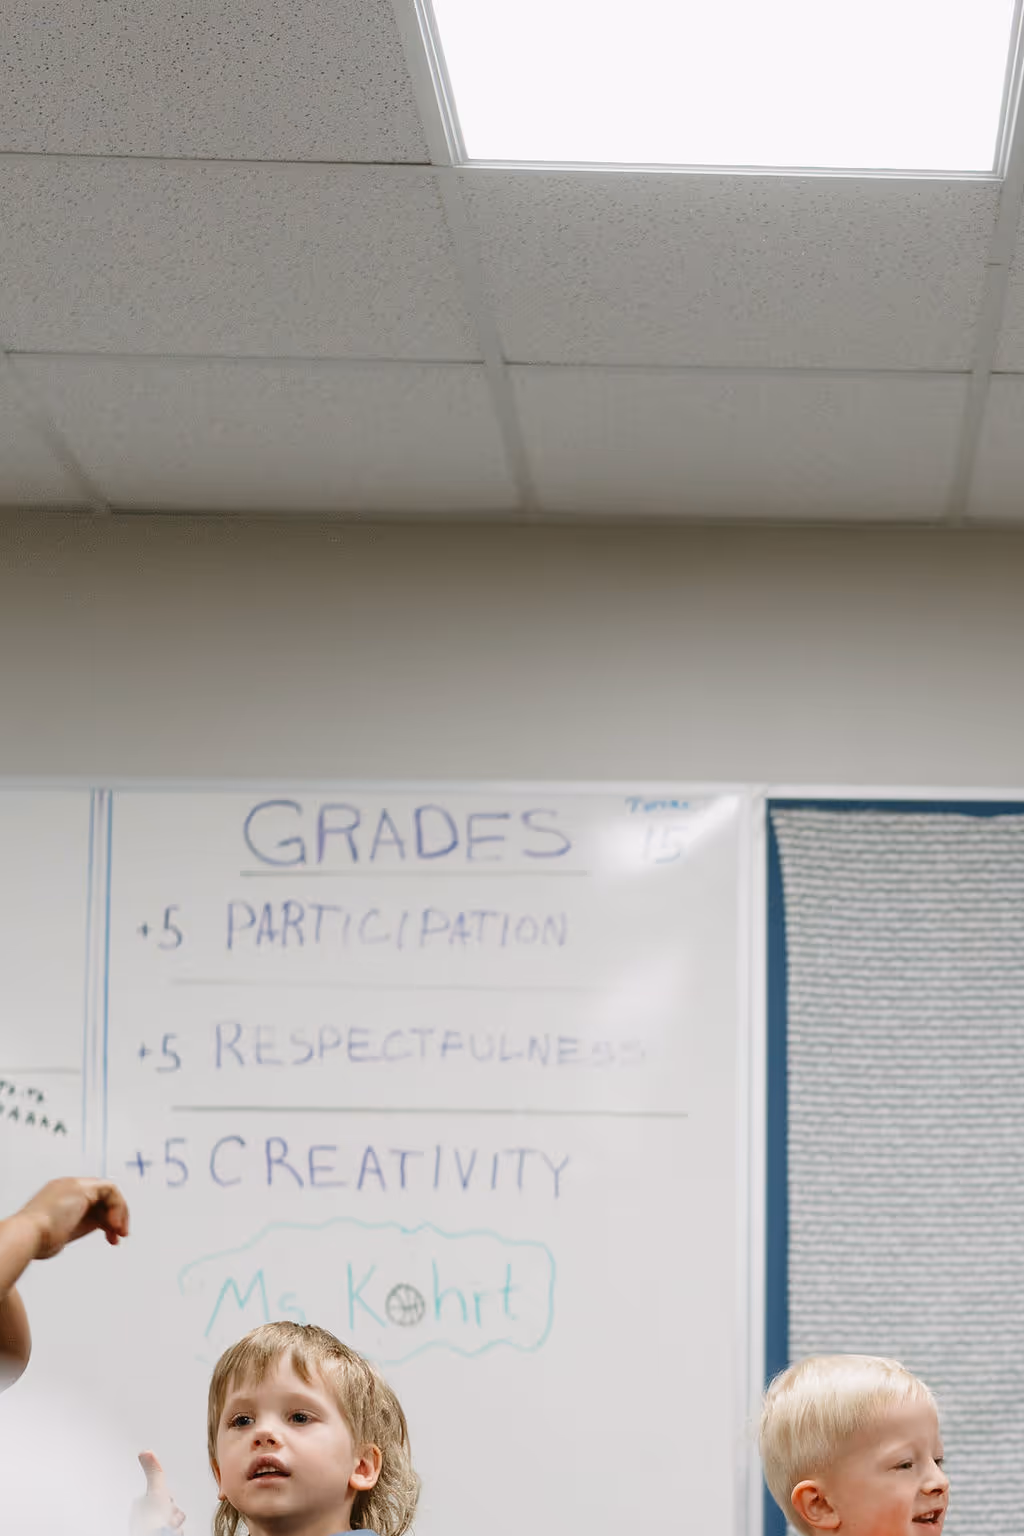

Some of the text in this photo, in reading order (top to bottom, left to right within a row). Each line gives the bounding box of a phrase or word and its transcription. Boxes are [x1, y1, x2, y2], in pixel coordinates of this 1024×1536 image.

[243, 799, 572, 866] GRADES
[136, 899, 569, 951] +5 PARTICIPATION
[137, 1022, 648, 1074] +5 RESPECTFULNESS
[125, 1134, 571, 1199] +5 CREATIVITY
